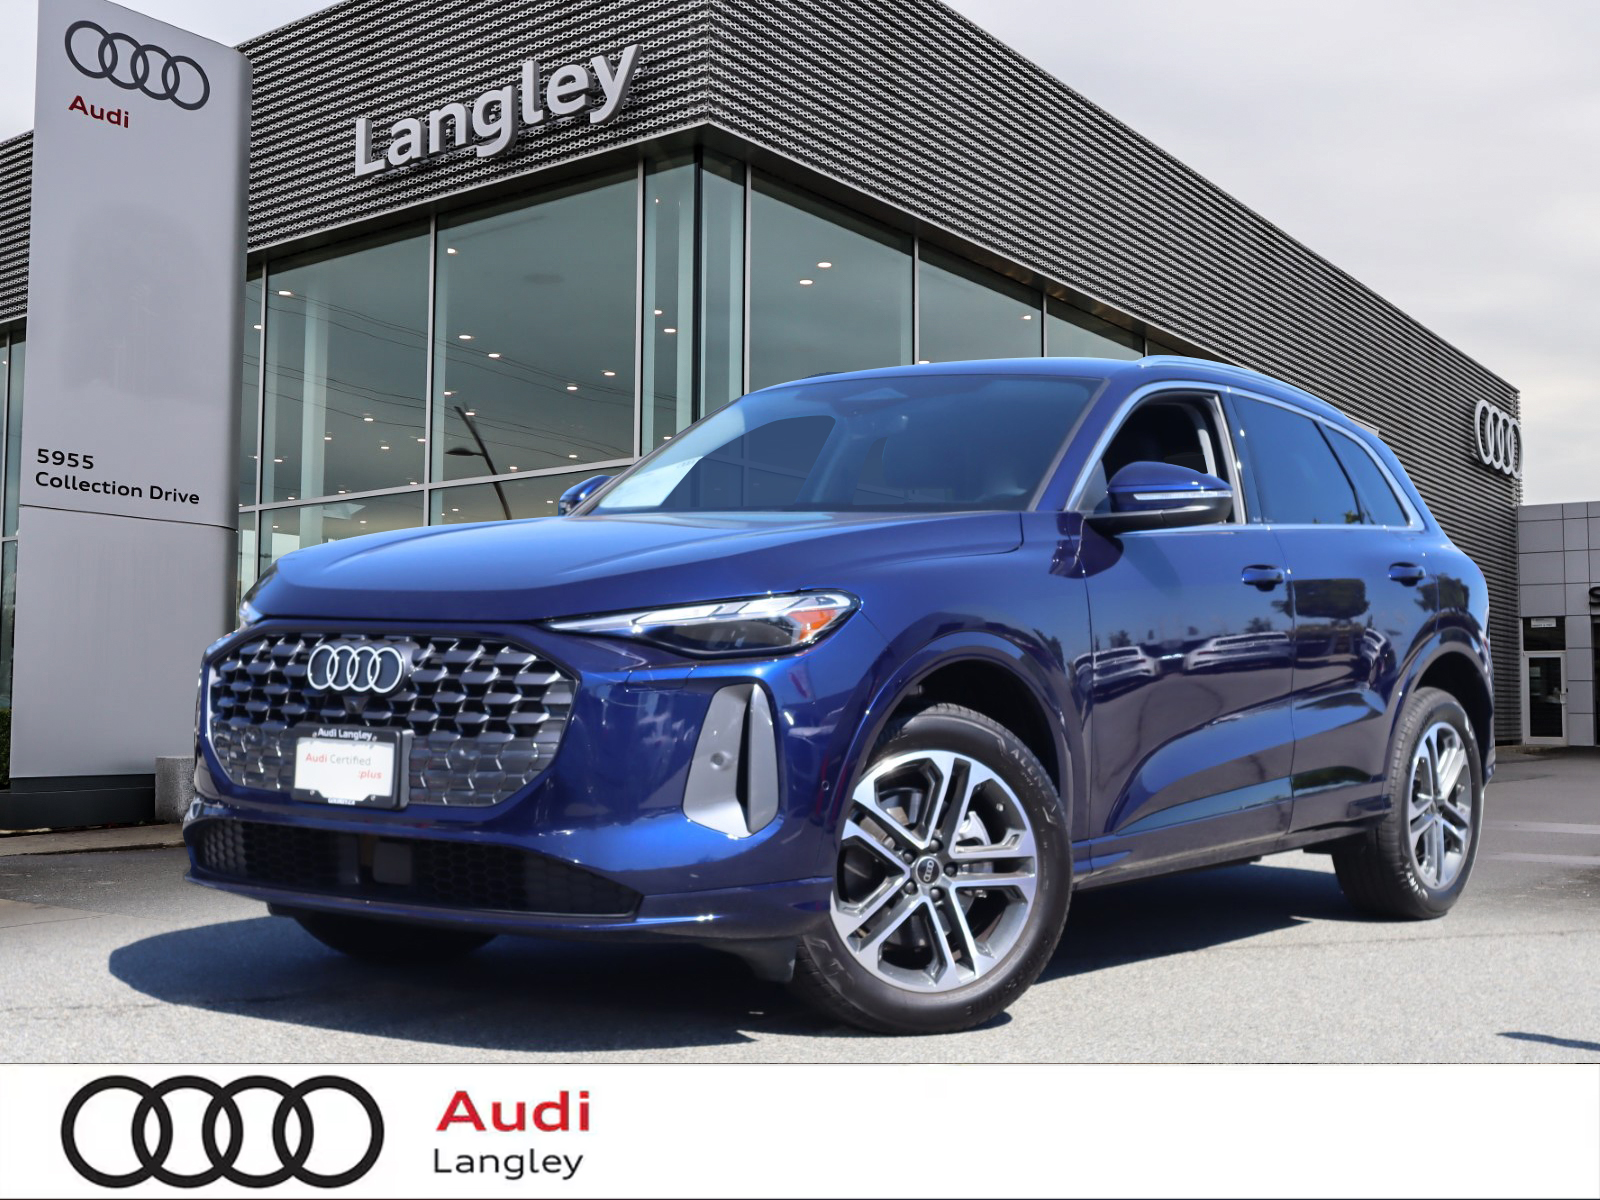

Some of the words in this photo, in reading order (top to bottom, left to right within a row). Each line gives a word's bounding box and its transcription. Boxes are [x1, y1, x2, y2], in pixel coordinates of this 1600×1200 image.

[68, 95, 129, 129] Audi
[355, 44, 642, 177] Langley
[37, 448, 95, 470] 5955
[35, 471, 143, 498] Collection
[149, 485, 200, 505] Drive
[318, 728, 337, 738] Audi
[339, 730, 373, 742] Langley
[305, 752, 328, 763] Audi
[329, 753, 372, 766] Certified
